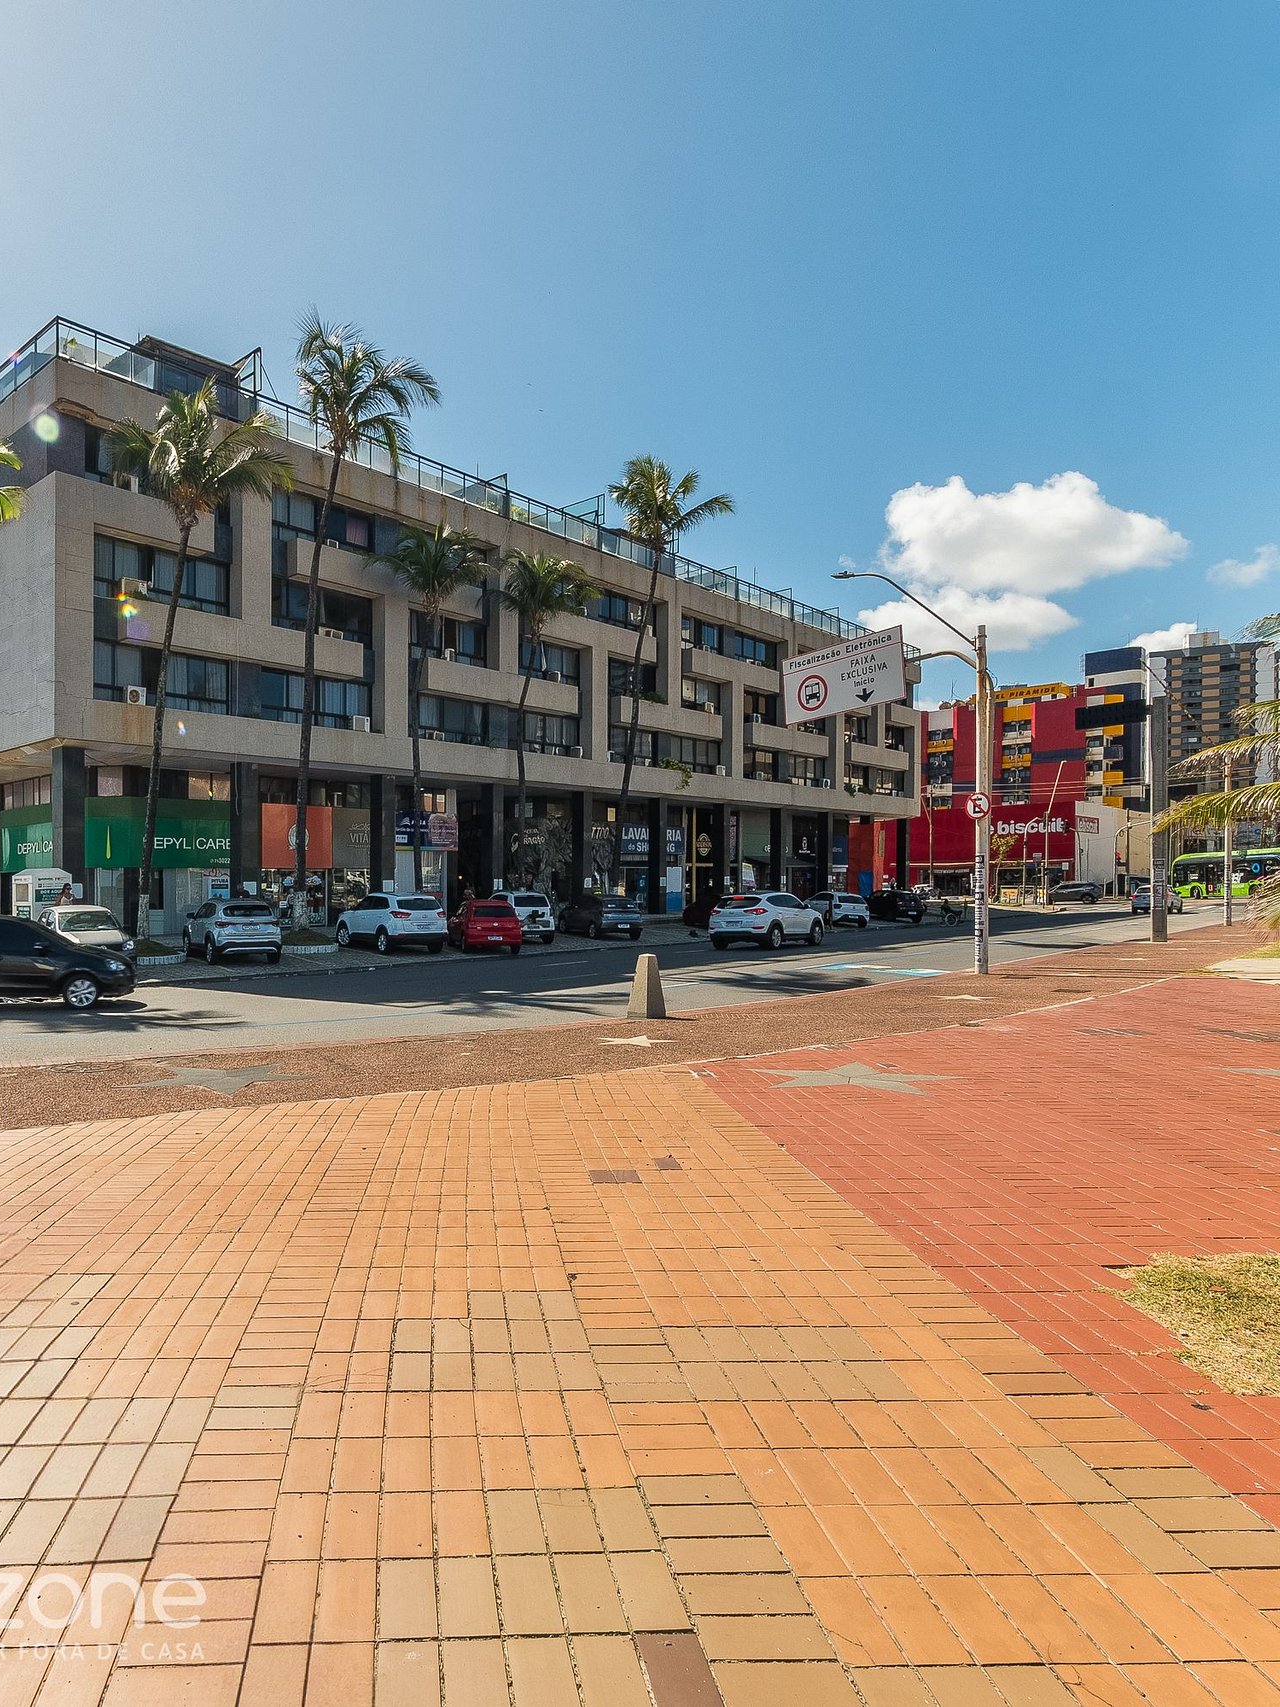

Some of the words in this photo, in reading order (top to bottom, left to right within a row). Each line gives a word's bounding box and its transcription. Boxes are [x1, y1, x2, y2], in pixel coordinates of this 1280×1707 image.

[789, 649, 841, 670] Fiscalização
[845, 634, 892, 654] Eletrônica
[850, 654, 876, 668] FAIXA
[841, 662, 888, 681] EXCLUSIVA
[997, 817, 1064, 836] biscuit
[42, 840, 54, 853] CA
[153, 837, 191, 849] EPYL
